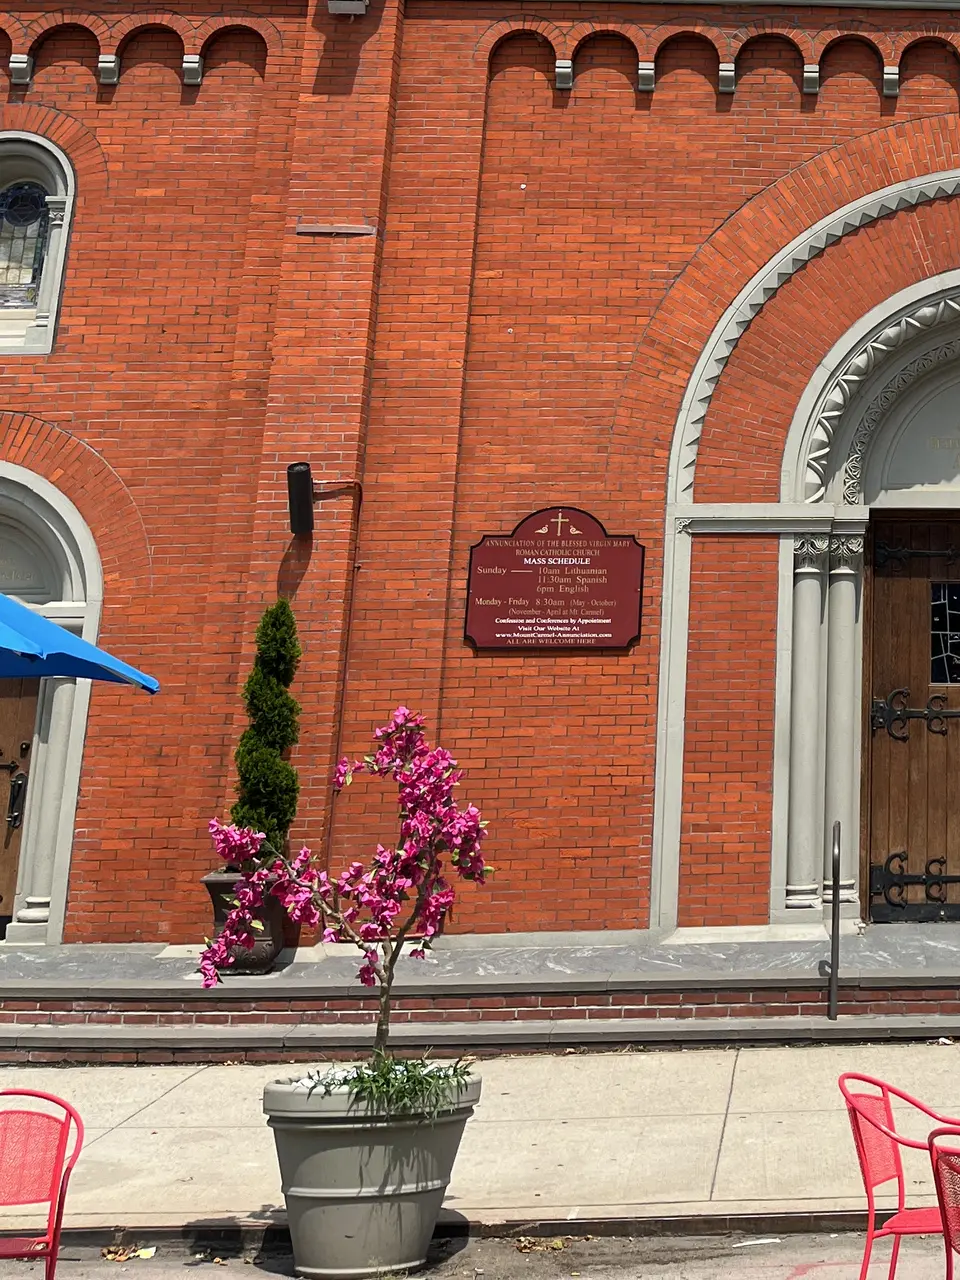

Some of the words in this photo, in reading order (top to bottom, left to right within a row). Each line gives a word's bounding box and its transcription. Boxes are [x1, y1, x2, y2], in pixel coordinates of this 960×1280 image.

[477, 566, 507, 575] Sunday
[576, 576, 607, 585] Spanish
[536, 585, 554, 594] 6pm
[559, 585, 589, 594] English
[475, 598, 502, 606] Monday
[508, 598, 529, 606] Friday
[591, 599, 616, 607] October)
